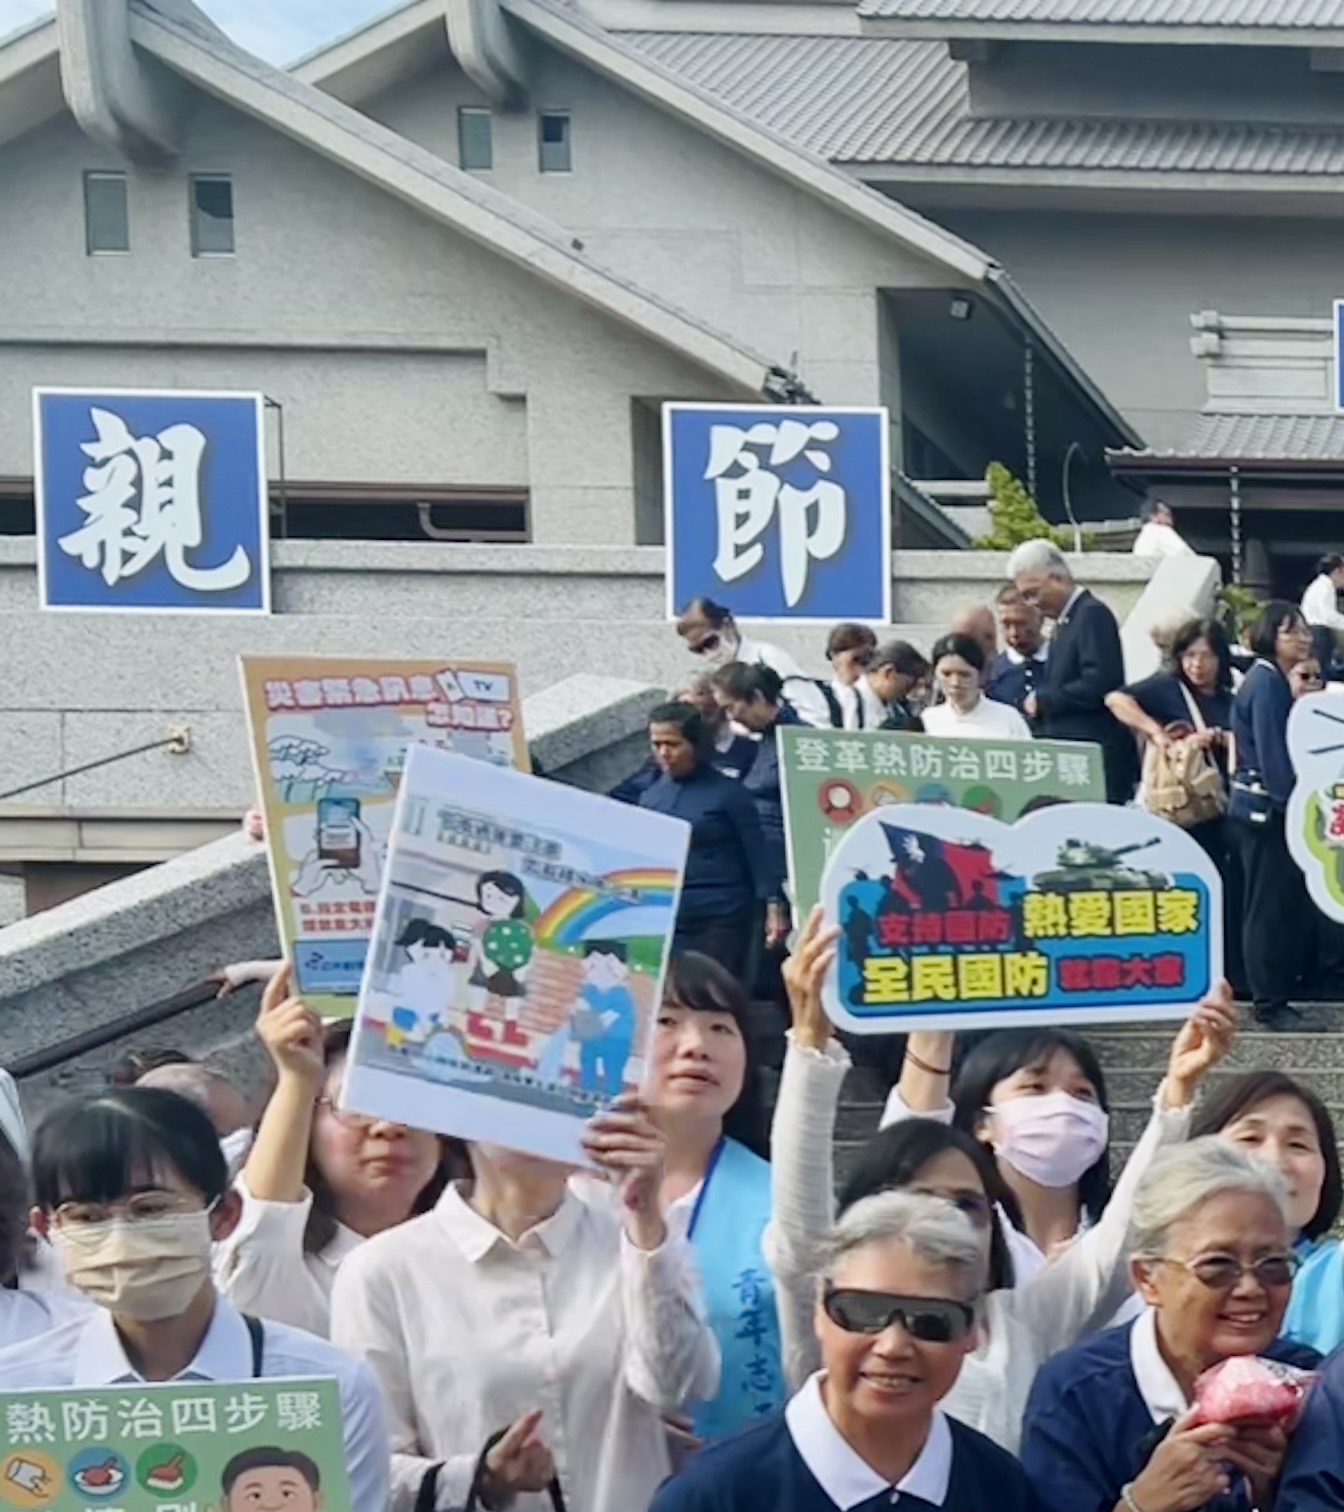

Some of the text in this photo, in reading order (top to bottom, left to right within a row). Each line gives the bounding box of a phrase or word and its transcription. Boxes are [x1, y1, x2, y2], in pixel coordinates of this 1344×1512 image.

[57, 405, 252, 592] 親
[702, 418, 847, 607] 節
[795, 736, 1092, 788] 登革熱防治四步驟
[1021, 889, 1200, 938] 熱愛國家
[862, 951, 1050, 1003] 全民國防
[732, 1268, 772, 1413] 青年志
[5, 1390, 323, 1445] 熱防治四步驟
